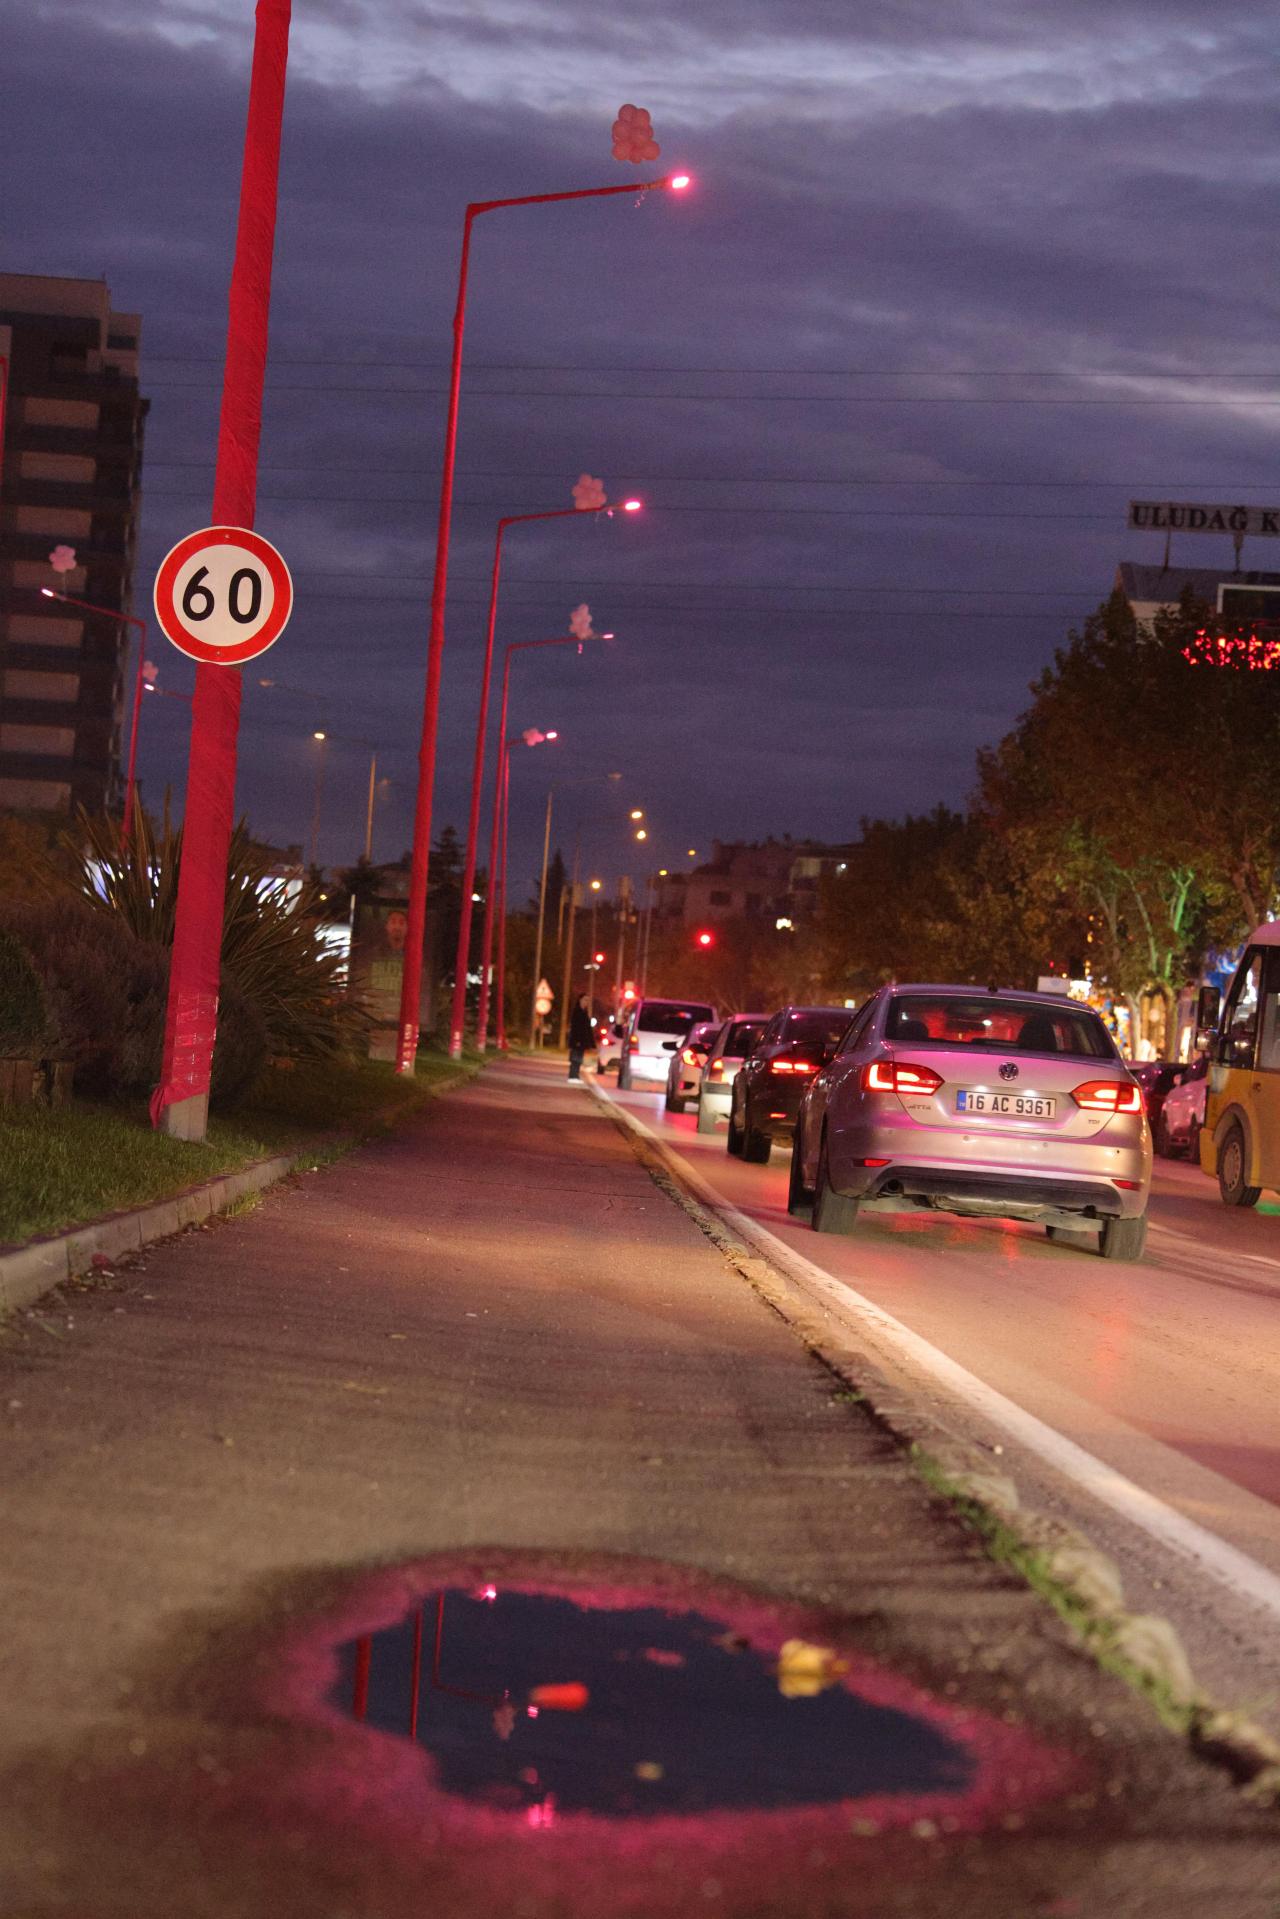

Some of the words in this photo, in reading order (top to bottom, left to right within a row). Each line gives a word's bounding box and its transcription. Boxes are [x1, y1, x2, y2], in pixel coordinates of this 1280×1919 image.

[1132, 505, 1248, 531] ULUDAĞ
[182, 565, 262, 625] 60
[968, 1094, 985, 1110] 16
[992, 1096, 1010, 1113] AC
[1016, 1098, 1052, 1117] 9361
